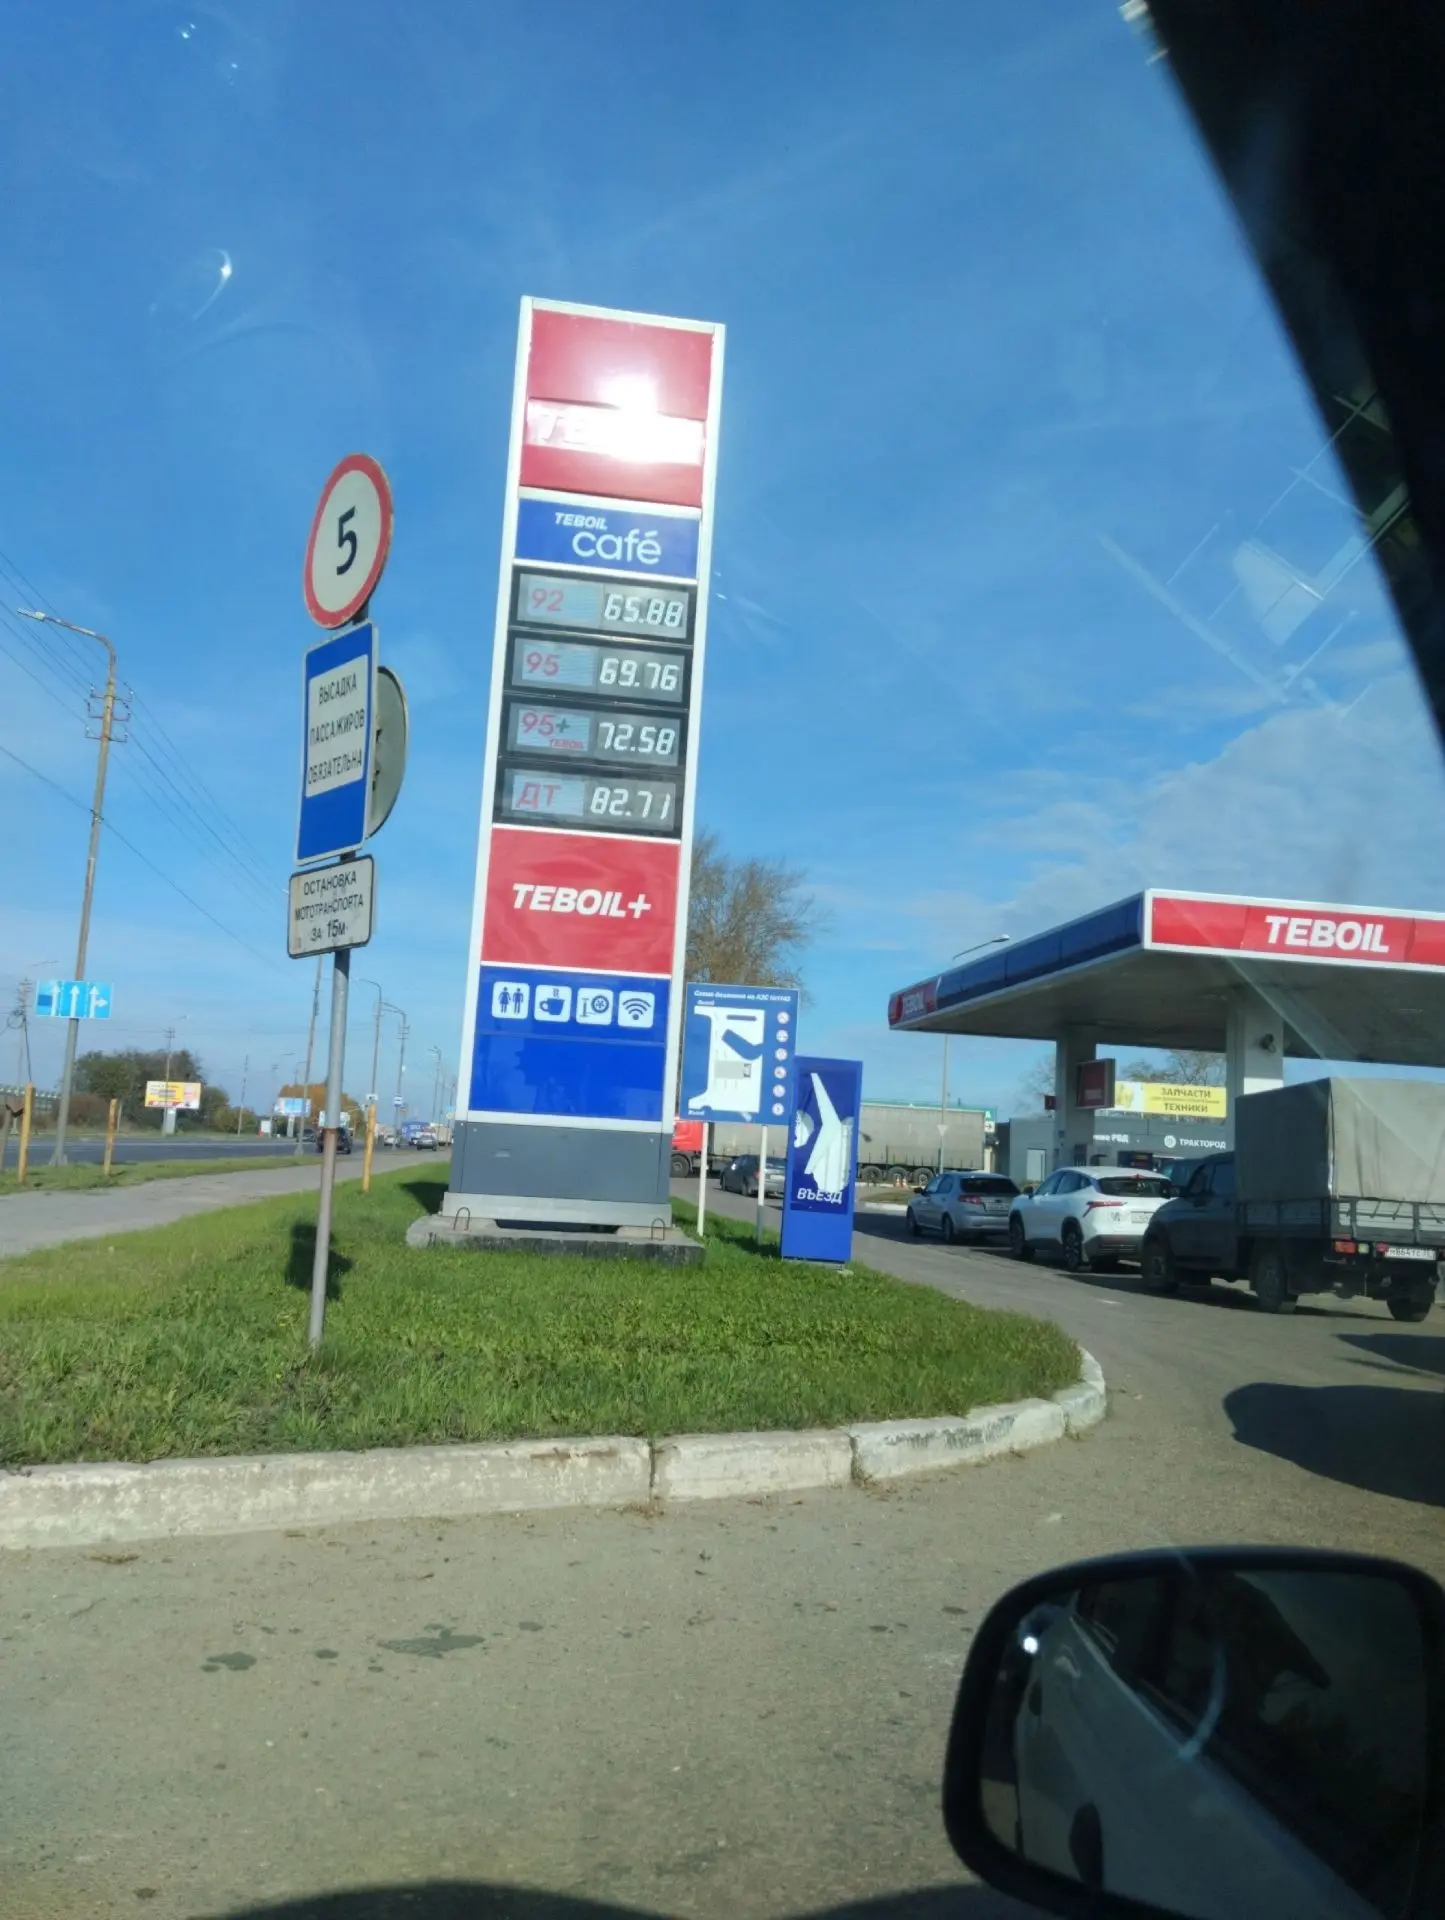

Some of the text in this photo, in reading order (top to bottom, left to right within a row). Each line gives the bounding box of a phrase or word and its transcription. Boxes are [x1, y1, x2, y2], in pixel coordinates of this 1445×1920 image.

[554, 512, 608, 530] TEBOIL
[336, 505, 358, 576] 5
[572, 528, 662, 565] café
[531, 588, 684, 628] 92 65.88
[319, 672, 358, 705] ВЫСАДКА
[526, 651, 681, 691] 95 69.76
[309, 708, 366, 745] ПАССАЖИРОВ
[521, 710, 571, 736] 95+
[599, 722, 676, 755] 72.58
[308, 748, 363, 785] ОБЯЗАТЕЛЬНА
[515, 781, 671, 821] ДТ 82.71
[303, 870, 357, 896] ОСТАНОВКА
[294, 894, 364, 921] МОТОТРАНСПОРТА
[1265, 915, 1390, 953] TEBOIL
[1161, 1087, 1211, 1099] ЗАПЧАСТИ
[1164, 1102, 1208, 1113] ТЕХНИКИ
[797, 1188, 843, 1205] ВЪЕЗД
